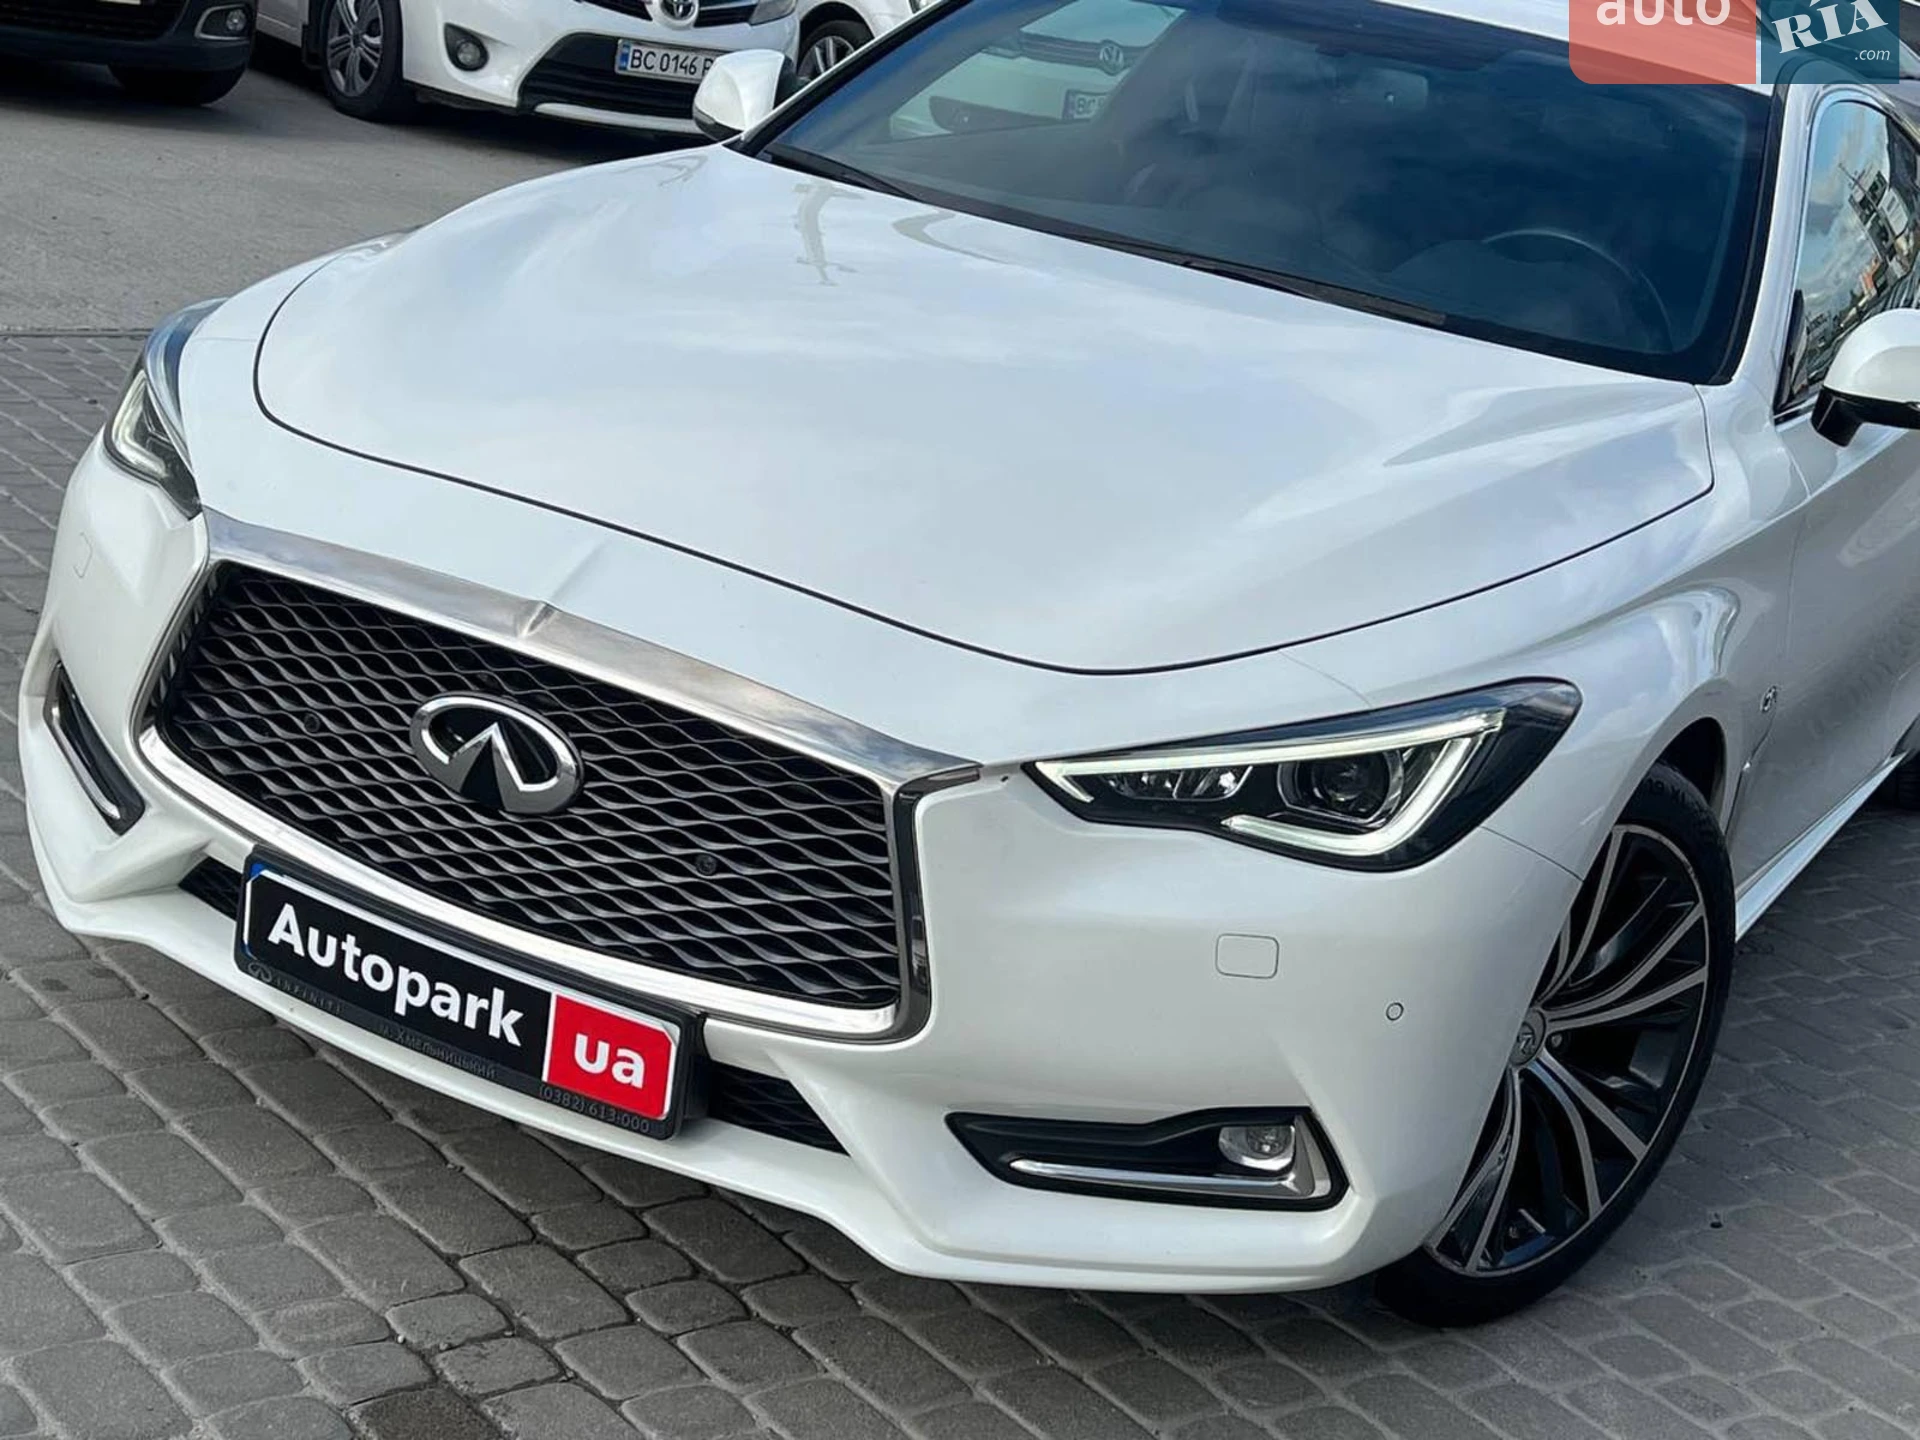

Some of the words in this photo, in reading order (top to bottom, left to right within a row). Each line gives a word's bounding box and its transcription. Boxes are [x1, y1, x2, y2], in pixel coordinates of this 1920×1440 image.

[630, 49, 656, 71] BC
[660, 53, 699, 75] 0146
[268, 902, 526, 1047] Autopark
[573, 1031, 646, 1090] ua
[539, 1084, 585, 1112] (0382)
